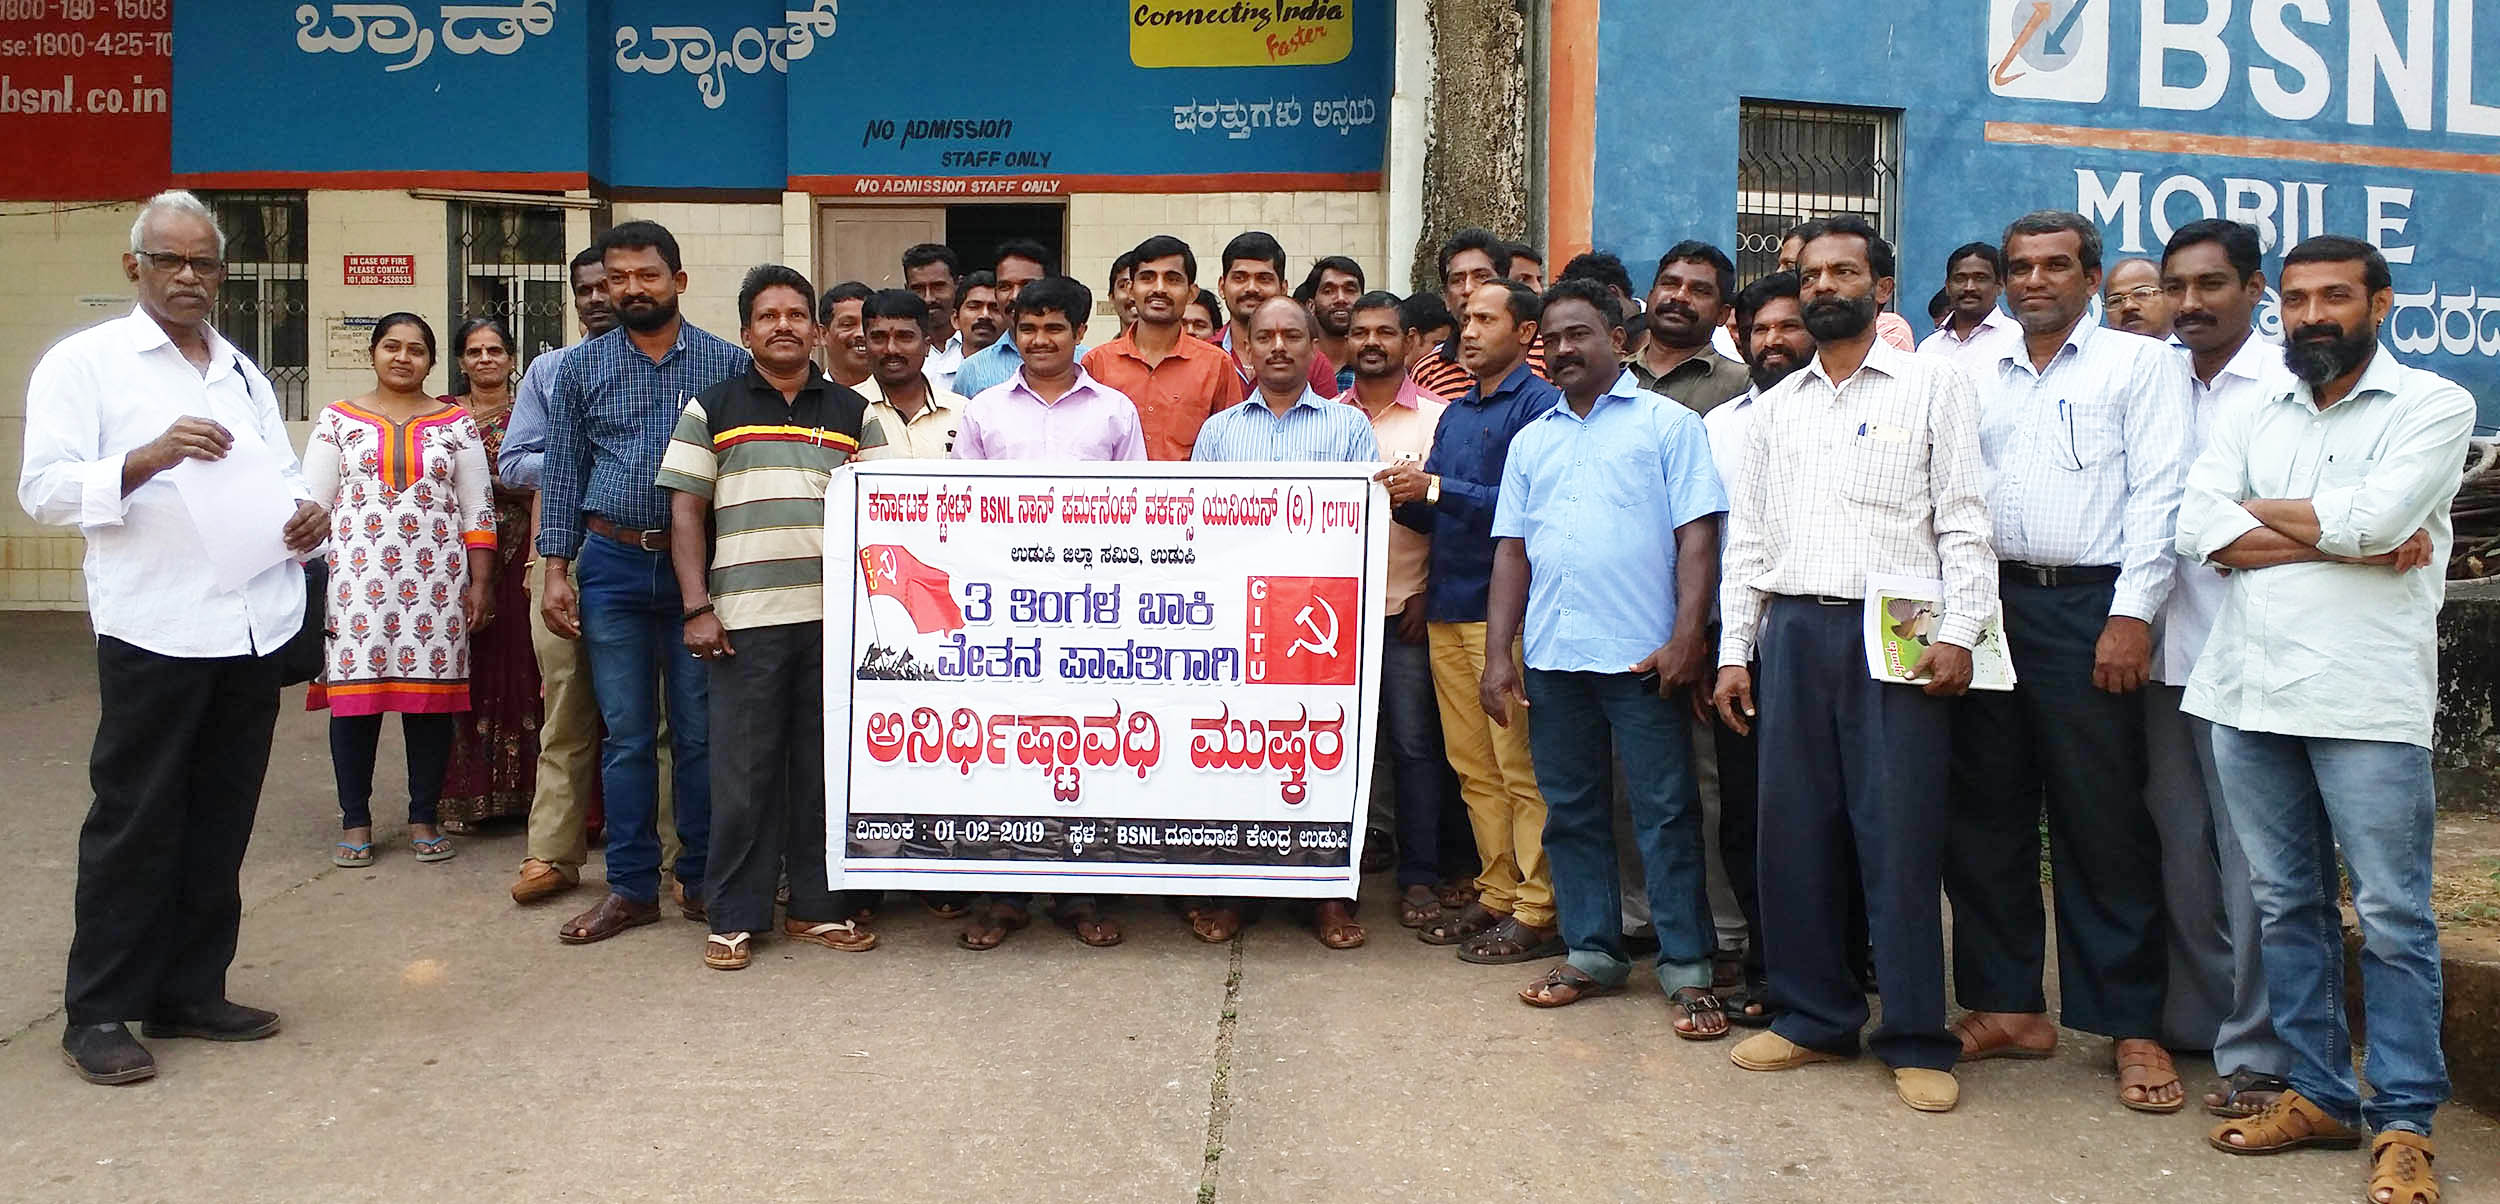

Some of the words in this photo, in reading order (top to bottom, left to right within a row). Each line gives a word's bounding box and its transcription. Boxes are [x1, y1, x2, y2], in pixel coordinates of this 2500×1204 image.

[296, 0, 556, 72] ಬ್ರಾಡ್
[1134, 2, 1272, 32] Connecting
[1276, 0, 1345, 23] India
[1265, 25, 1328, 61] Faster
[2139, 0, 2500, 135] BSNL
[862, 119, 895, 148] NO
[1173, 97, 1301, 139] ಷರತ್ತುಗಳು
[941, 151, 1002, 168] STAFF
[1004, 151, 1051, 168] ONLY
[855, 179, 879, 193] NO
[970, 180, 1017, 193] STAFF
[1021, 180, 1060, 193] ONLY
[349, 266, 375, 274] PLEASE
[376, 266, 409, 274] CONTACT
[350, 257, 358, 265] IN
[360, 257, 378, 265] CASE
[379, 257, 390, 265] OF
[391, 257, 407, 265] FIRE
[868, 484, 929, 523] ಕರ್ನಾಟಕ
[936, 484, 973, 543] ಸ್ಟೇಟ್
[980, 496, 1014, 523] BSNL
[1018, 486, 1055, 524] ನಾನ್
[1202, 487, 1278, 526] ಯುನಿಯನ್
[1286, 485, 1314, 534] (ರಿ.)
[1321, 501, 1360, 534] [CITU]
[862, 548, 879, 590] CITU
[1011, 542, 1055, 563] ಉಡುಪಿ
[1063, 546, 1093, 570] ಜಿಲ್ಲಾ
[1100, 544, 1143, 565] ಸಮಿತಿ,
[1150, 544, 1196, 565] ಉಡುಪಿ
[1010, 583, 1121, 624] ತಿಂಗಳ
[1138, 591, 1215, 626] ಬಾಕಿ
[1249, 578, 1267, 681] CITU
[938, 633, 1042, 678] ವೇತನ
[1059, 639, 1239, 682] ಪಾವತಿಗಾಗಿ
[1189, 700, 1346, 805] ಮುಷ್ಕರ
[855, 818, 915, 840] ದಿನಾಂಕ
[934, 820, 1045, 843] 01-02-2019
[1069, 821, 1096, 856] ಸ್ಥಳ
[1117, 826, 1161, 845] BSNL
[1164, 823, 1239, 847] ದೂರವಾಣಿ
[1246, 824, 1292, 855] ಕೇಂದ್ರ
[1299, 825, 1348, 848] ಉಡುಪಿ
